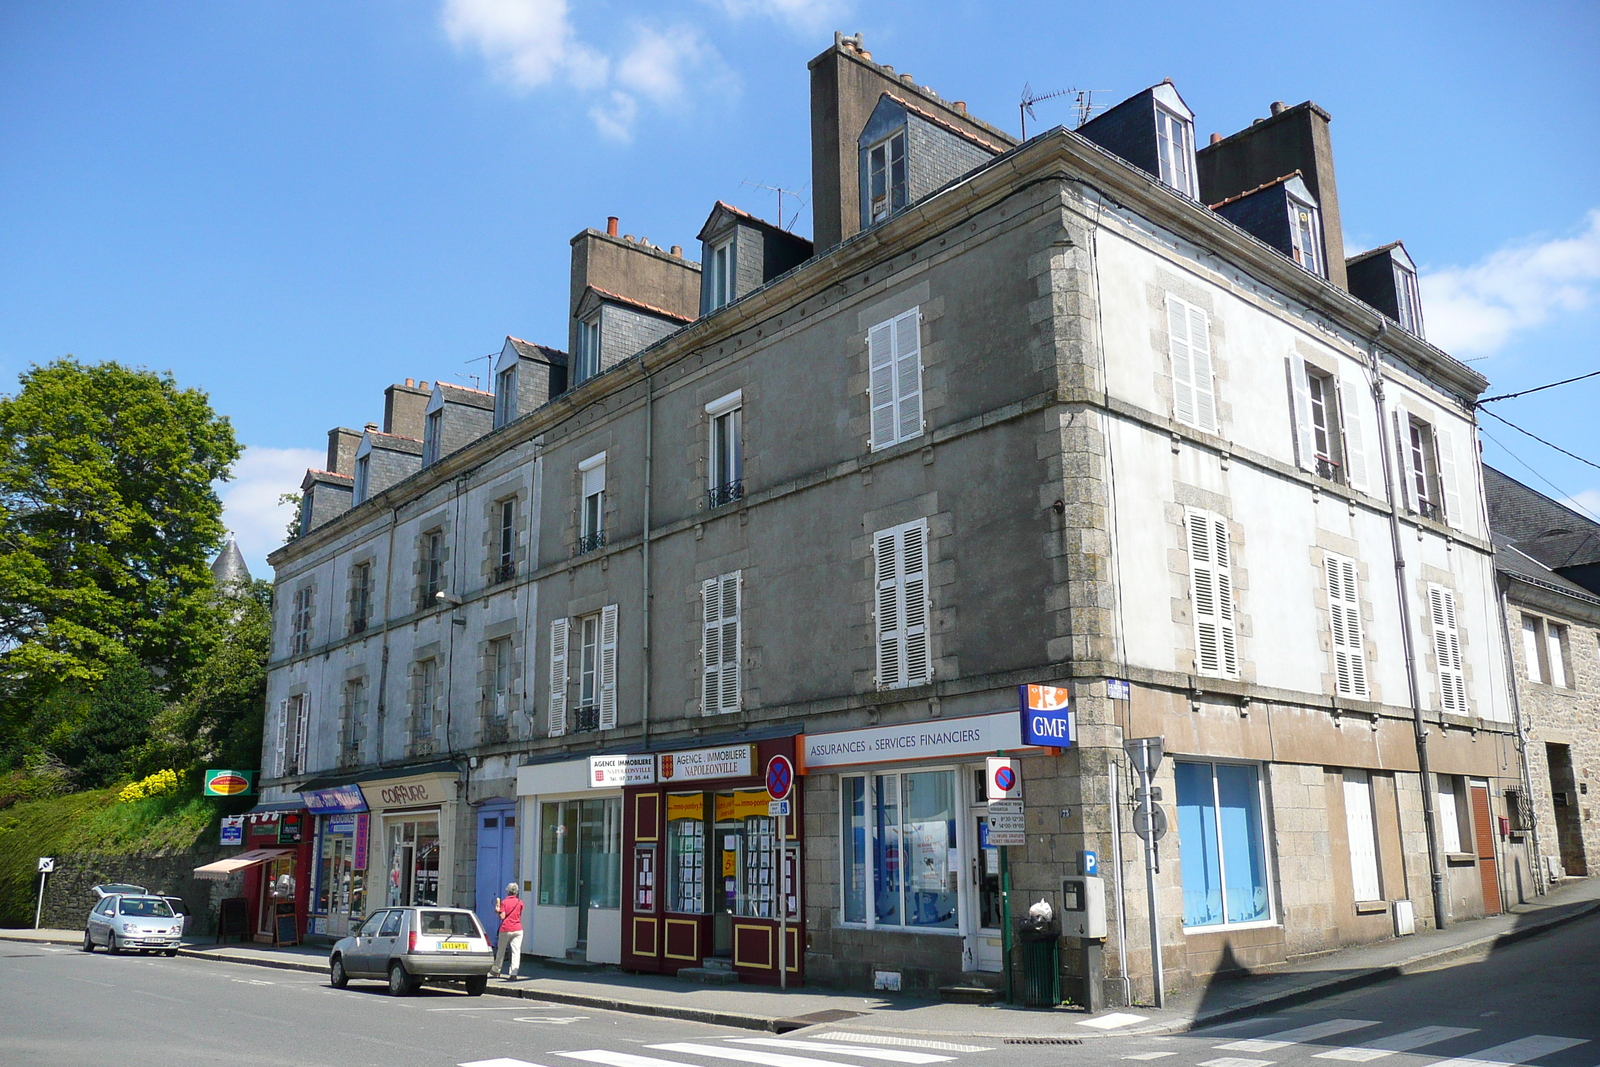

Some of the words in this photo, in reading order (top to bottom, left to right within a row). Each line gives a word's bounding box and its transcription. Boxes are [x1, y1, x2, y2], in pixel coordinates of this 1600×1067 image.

[1032, 716, 1067, 738] GMF
[810, 740, 866, 757] ASSURANCES
[875, 735, 916, 751] SERVICES
[920, 728, 980, 746] FINANCIERS
[594, 759, 616, 768] AGENCE
[617, 758, 652, 767] IMMOBILIERE
[676, 754, 702, 765] AGENCE
[706, 748, 747, 763] IMMOBILIERE
[606, 766, 651, 775] NAPOLEONVILLE
[684, 762, 739, 776] NAPOLEONVILLE
[357, 817, 366, 867] MUSIQUE
[1086, 855, 1095, 871] P
